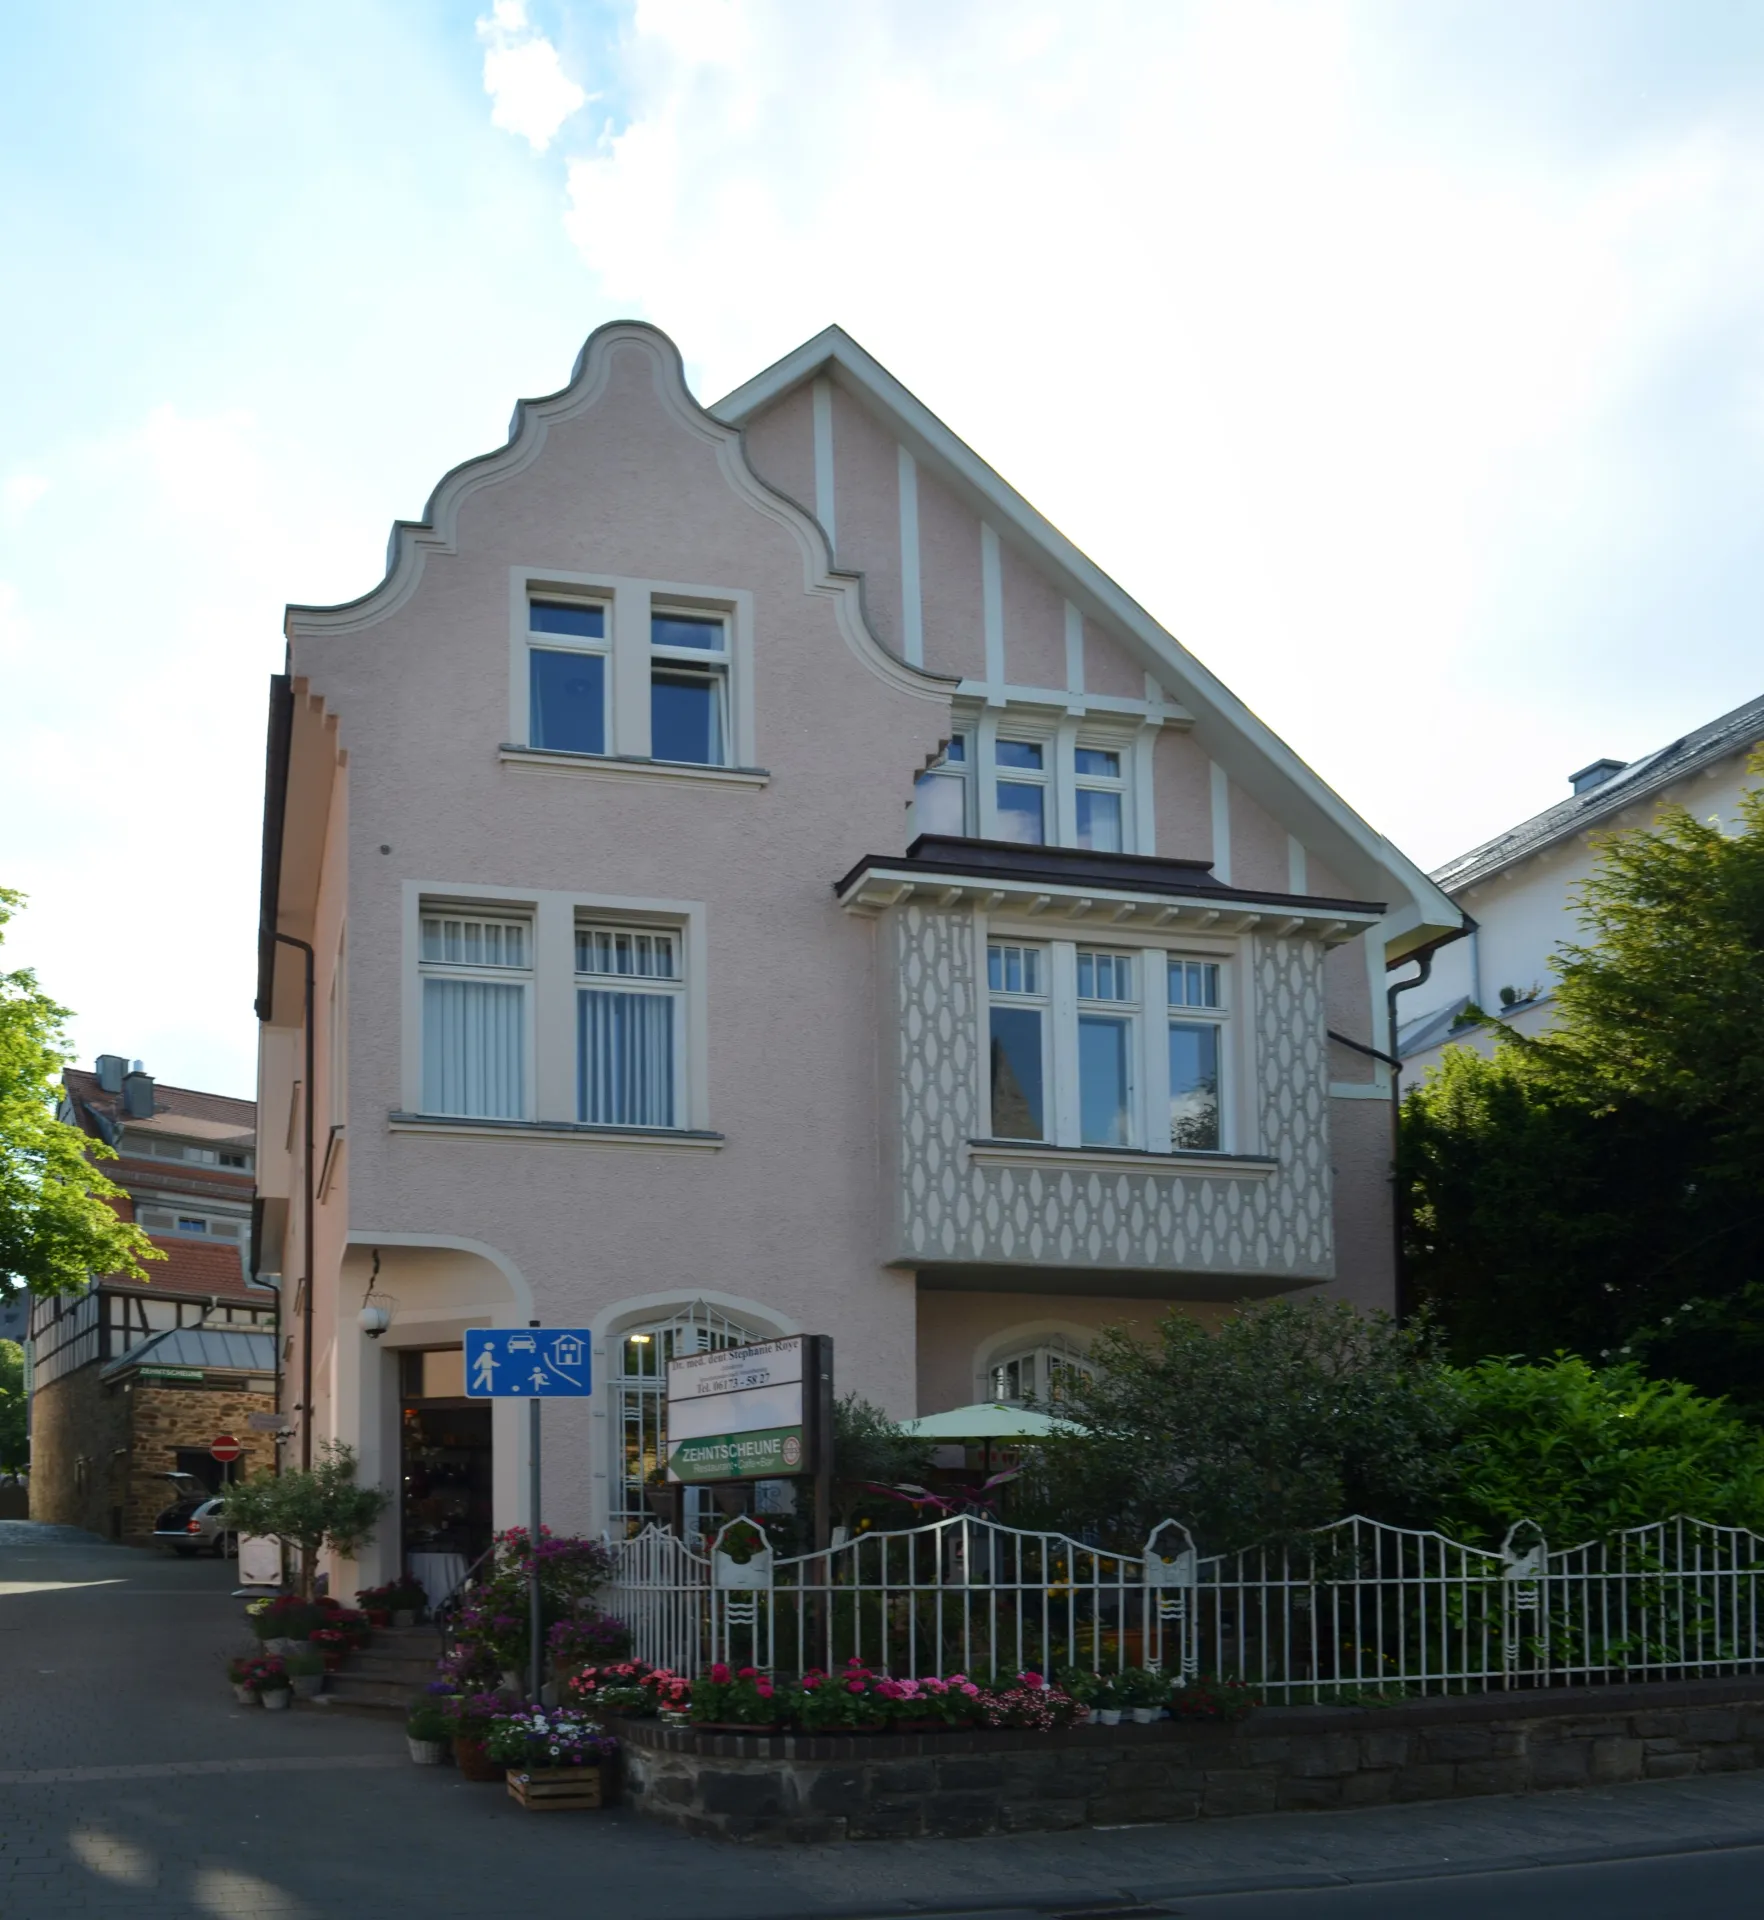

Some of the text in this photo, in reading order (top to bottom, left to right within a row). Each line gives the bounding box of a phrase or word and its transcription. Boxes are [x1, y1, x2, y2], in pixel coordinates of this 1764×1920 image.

[672, 1361, 684, 1370] Dr.
[687, 1358, 706, 1368] med.
[729, 1344, 773, 1360] Stephanie
[697, 1384, 710, 1393] Tel.
[682, 1439, 781, 1463] ZEHNTSCHEUNE
